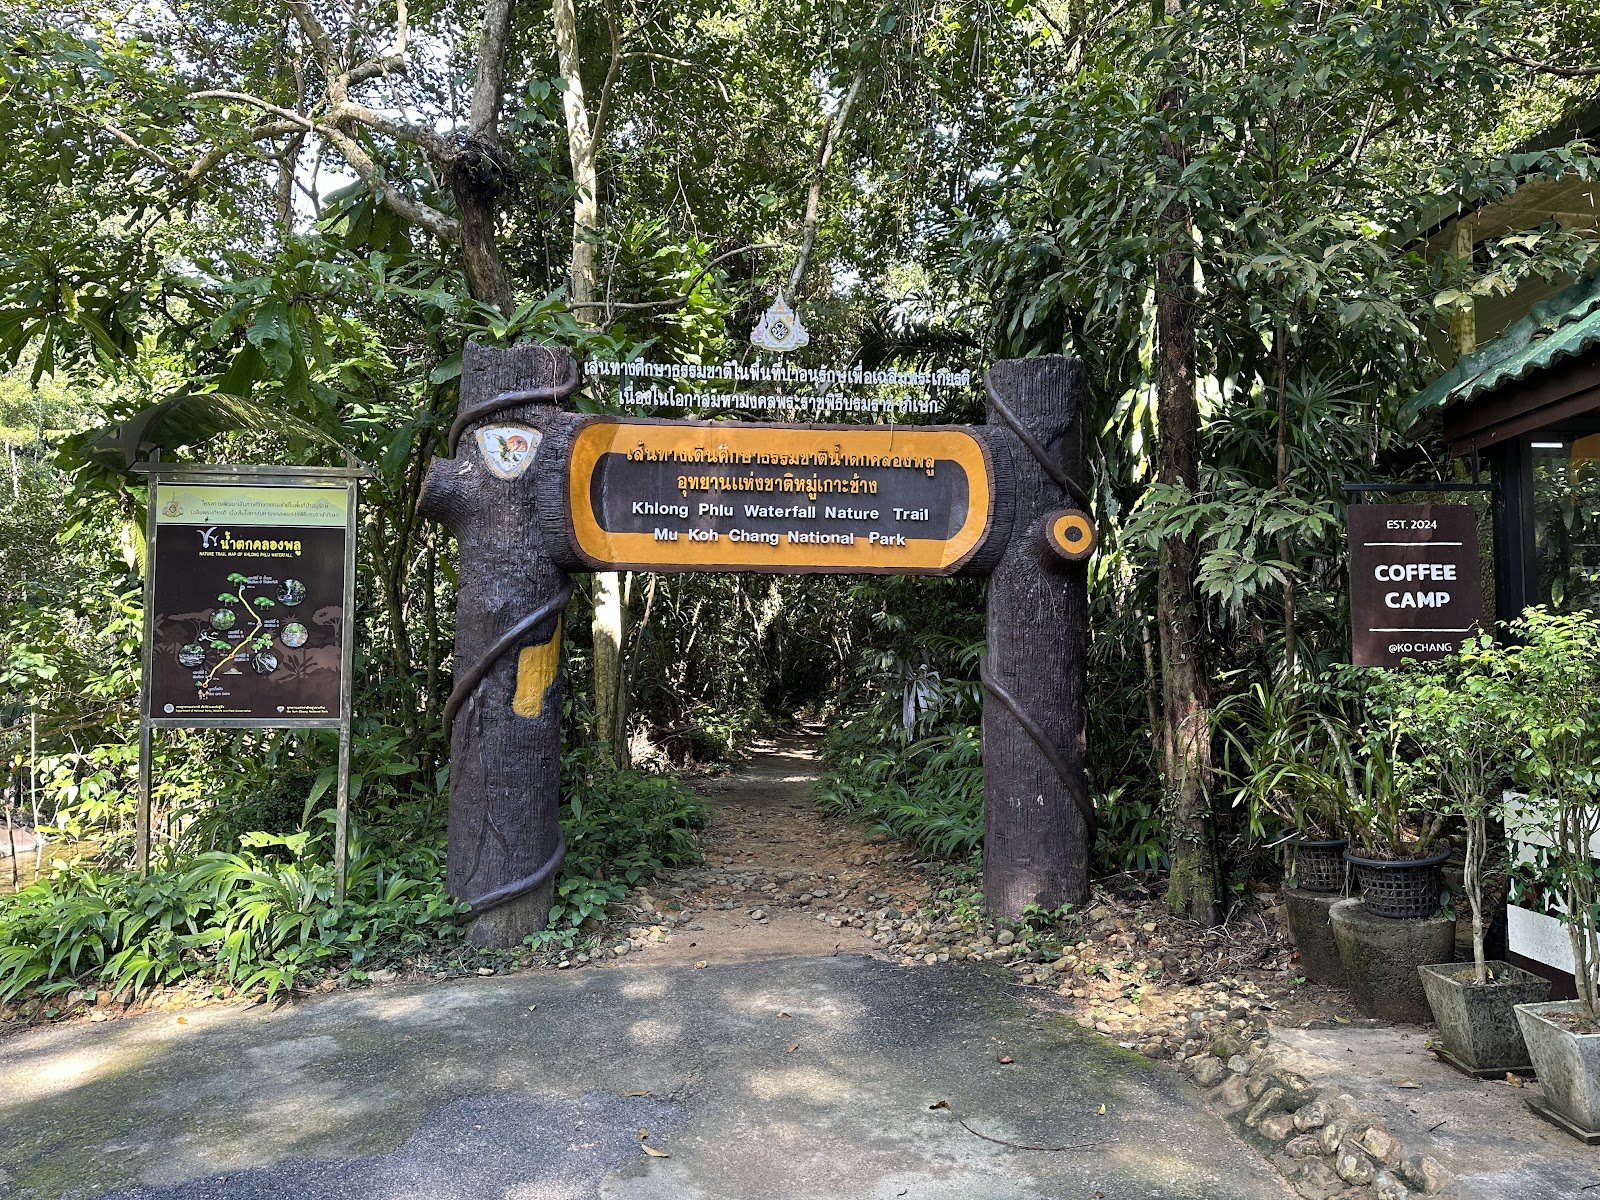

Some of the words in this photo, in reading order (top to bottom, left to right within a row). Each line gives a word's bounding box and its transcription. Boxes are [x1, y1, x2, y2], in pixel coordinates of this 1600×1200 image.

[677, 472, 878, 500] อุทยานแห่งชาติหมู่เกาะช้าง
[632, 502, 689, 518] Khlong
[699, 503, 734, 516] Phlu
[744, 505, 816, 518] Waterfall
[825, 506, 880, 520] Nature
[893, 508, 929, 521] Trail
[1386, 520, 1409, 530] EST.
[1411, 519, 1437, 529] 2024
[220, 530, 302, 556] น้ำตกคลองพลู
[654, 528, 678, 541] Mu
[688, 529, 719, 541] Koh
[729, 529, 779, 545] Chang
[787, 531, 854, 545] National
[869, 532, 906, 546] Park
[1374, 564, 1457, 581] COFFEE
[1384, 592, 1450, 609] CAMP
[1388, 643, 1412, 654] @KO
[1414, 643, 1453, 652] CHANG
